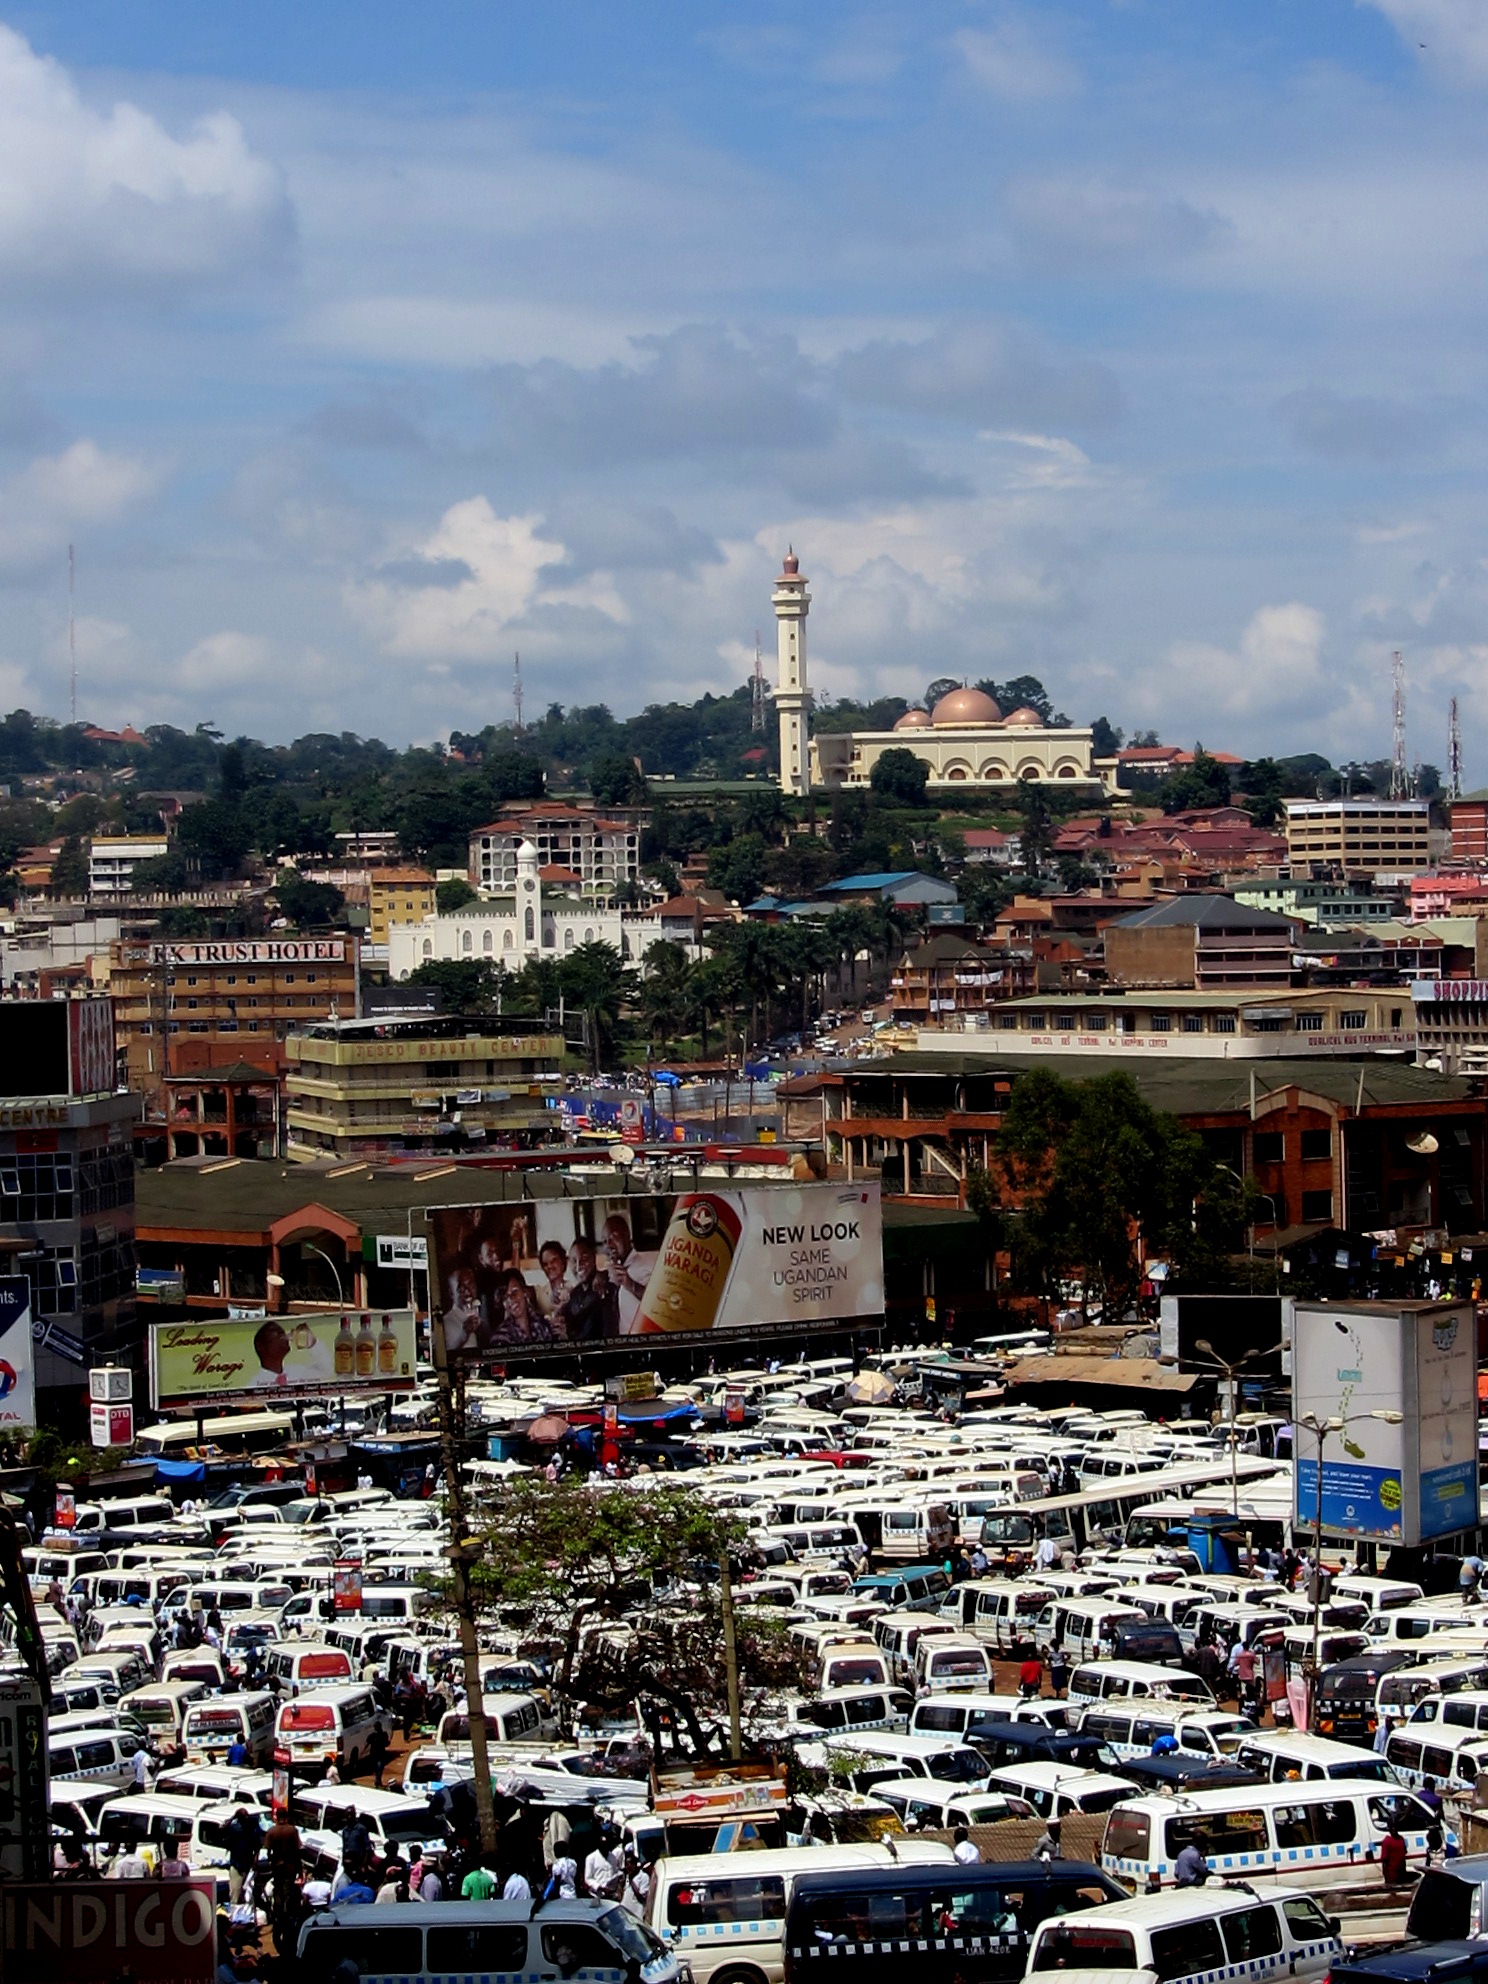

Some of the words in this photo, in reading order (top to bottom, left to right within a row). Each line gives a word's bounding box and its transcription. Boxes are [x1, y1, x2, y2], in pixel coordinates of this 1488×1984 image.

[191, 944, 260, 962] TRUST
[268, 942, 340, 960] HOTEL
[420, 1041, 476, 1056] BEAUTY
[491, 1038, 548, 1054] CENTER
[0, 1106, 69, 1126] CENTRE
[763, 1225, 805, 1245] NEW
[811, 1221, 860, 1242] LOOK
[667, 1235, 720, 1271] UGANDA
[790, 1248, 831, 1266] SAME
[663, 1252, 715, 1289] WARAGI
[773, 1266, 848, 1286] UGANDAN
[793, 1285, 834, 1303] SPIRIT
[192, 1353, 245, 1380] Waragi
[5, 1889, 213, 1949] INDIGO
